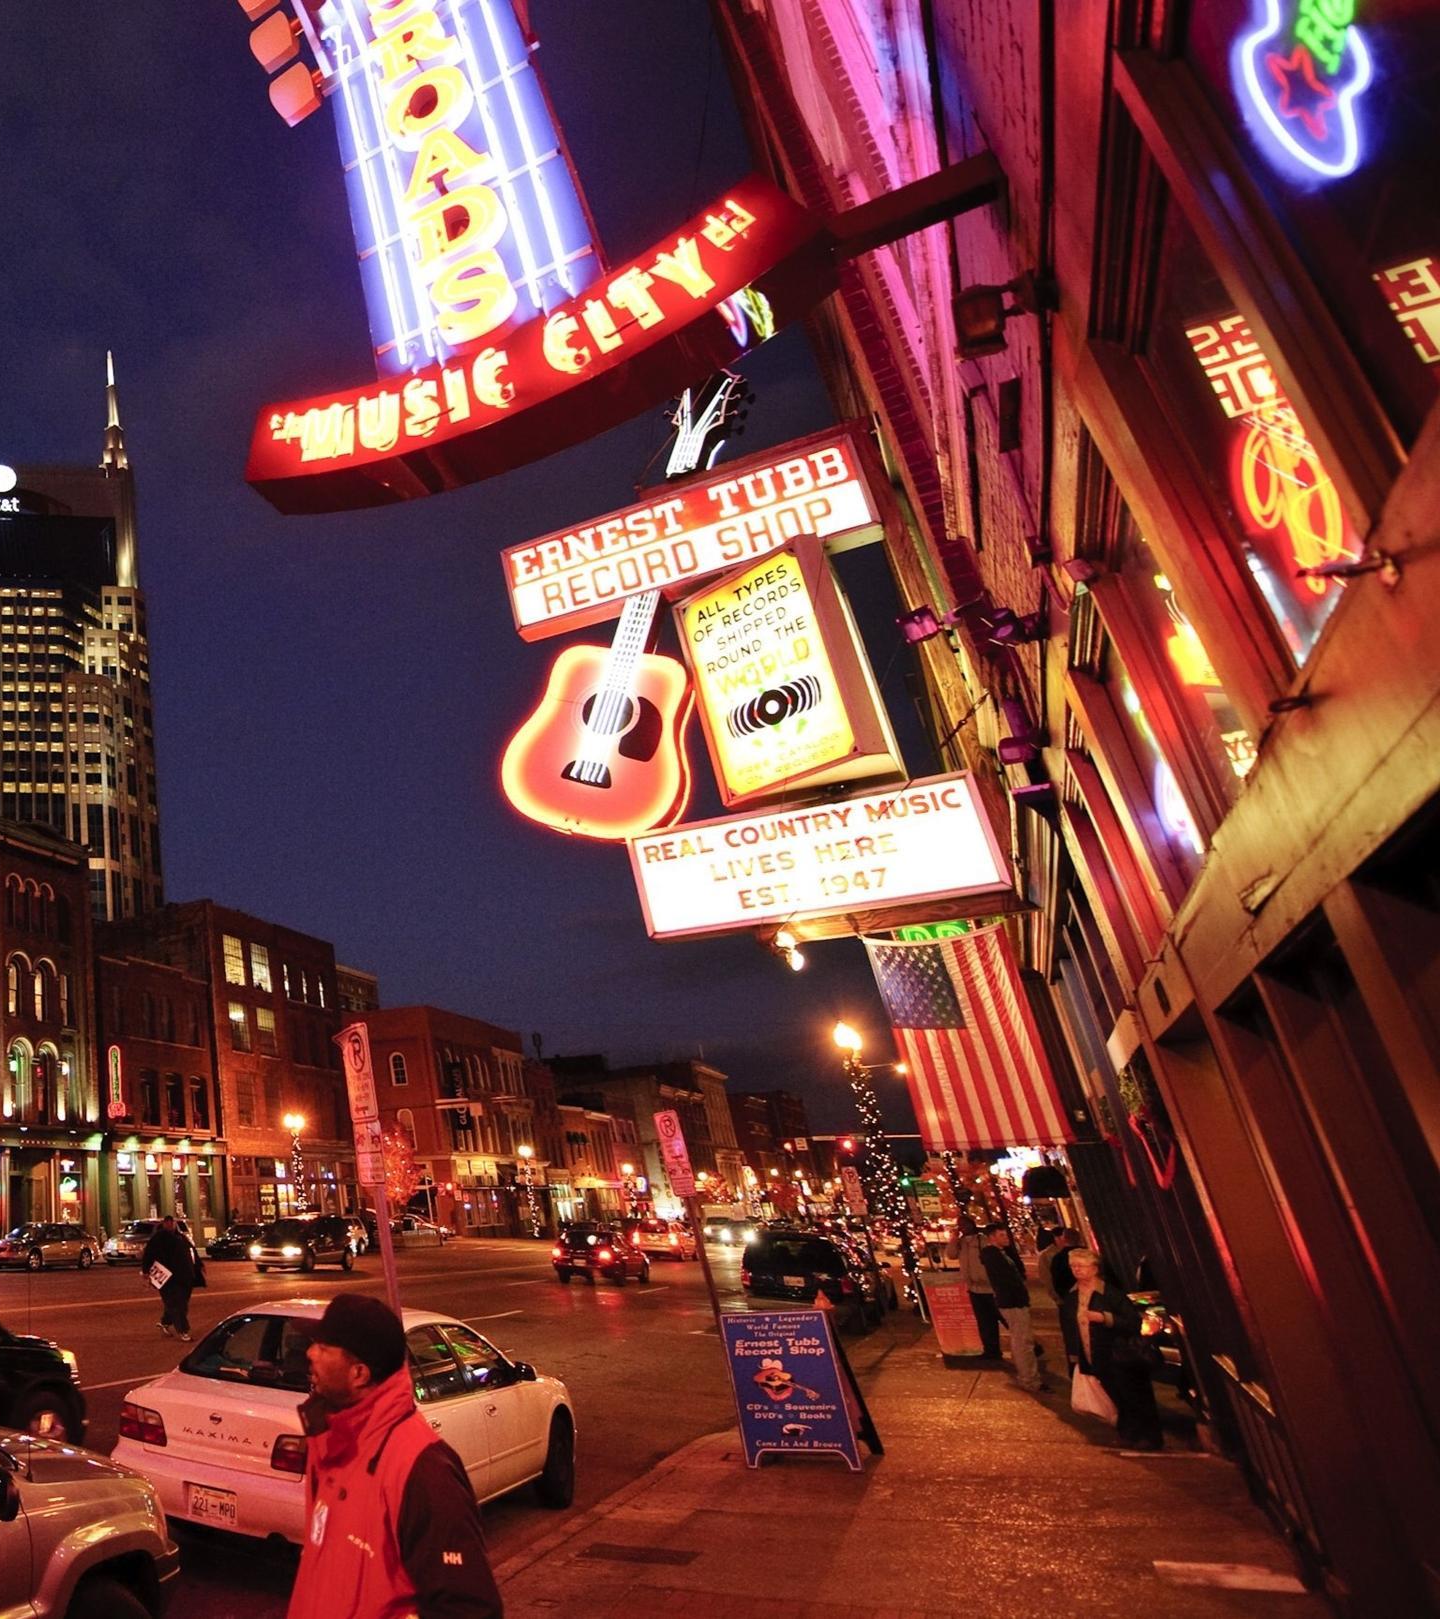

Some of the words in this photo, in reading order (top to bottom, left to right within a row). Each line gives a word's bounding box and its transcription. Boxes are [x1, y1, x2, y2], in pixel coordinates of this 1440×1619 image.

[366, 0, 518, 345] ROADS
[300, 347, 515, 462] MUSIC
[543, 236, 717, 374] CITY
[510, 498, 684, 585] ERNEST
[707, 446, 850, 514] TUBB
[541, 539, 698, 614] RECORD
[716, 496, 833, 562] SHOP
[693, 623, 713, 642] OF
[722, 577, 801, 625] RECORDS
[696, 600, 725, 622] ALL
[733, 564, 788, 601] TYPES
[706, 639, 762, 674] ROUND
[773, 615, 808, 640] THE
[716, 606, 787, 650] SHIPPED
[715, 636, 810, 695] WORLD
[643, 833, 716, 864] REAL
[724, 807, 852, 848] COUNTRY
[863, 787, 963, 825] MUSIC
[711, 850, 796, 883] LIVES
[817, 833, 899, 866] HERE
[738, 881, 800, 911] EST.
[820, 867, 888, 897] 1947
[734, 1346, 783, 1356] Record
[789, 1346, 825, 1356] Shop
[735, 1339, 780, 1348] Ernest
[785, 1337, 820, 1347] Tubb
[784, 1403, 837, 1411] Souvenirs
[799, 1412, 832, 1420] Books
[182, 1426, 252, 1445] MAXIMA
[443, 1551, 463, 1565] HH
